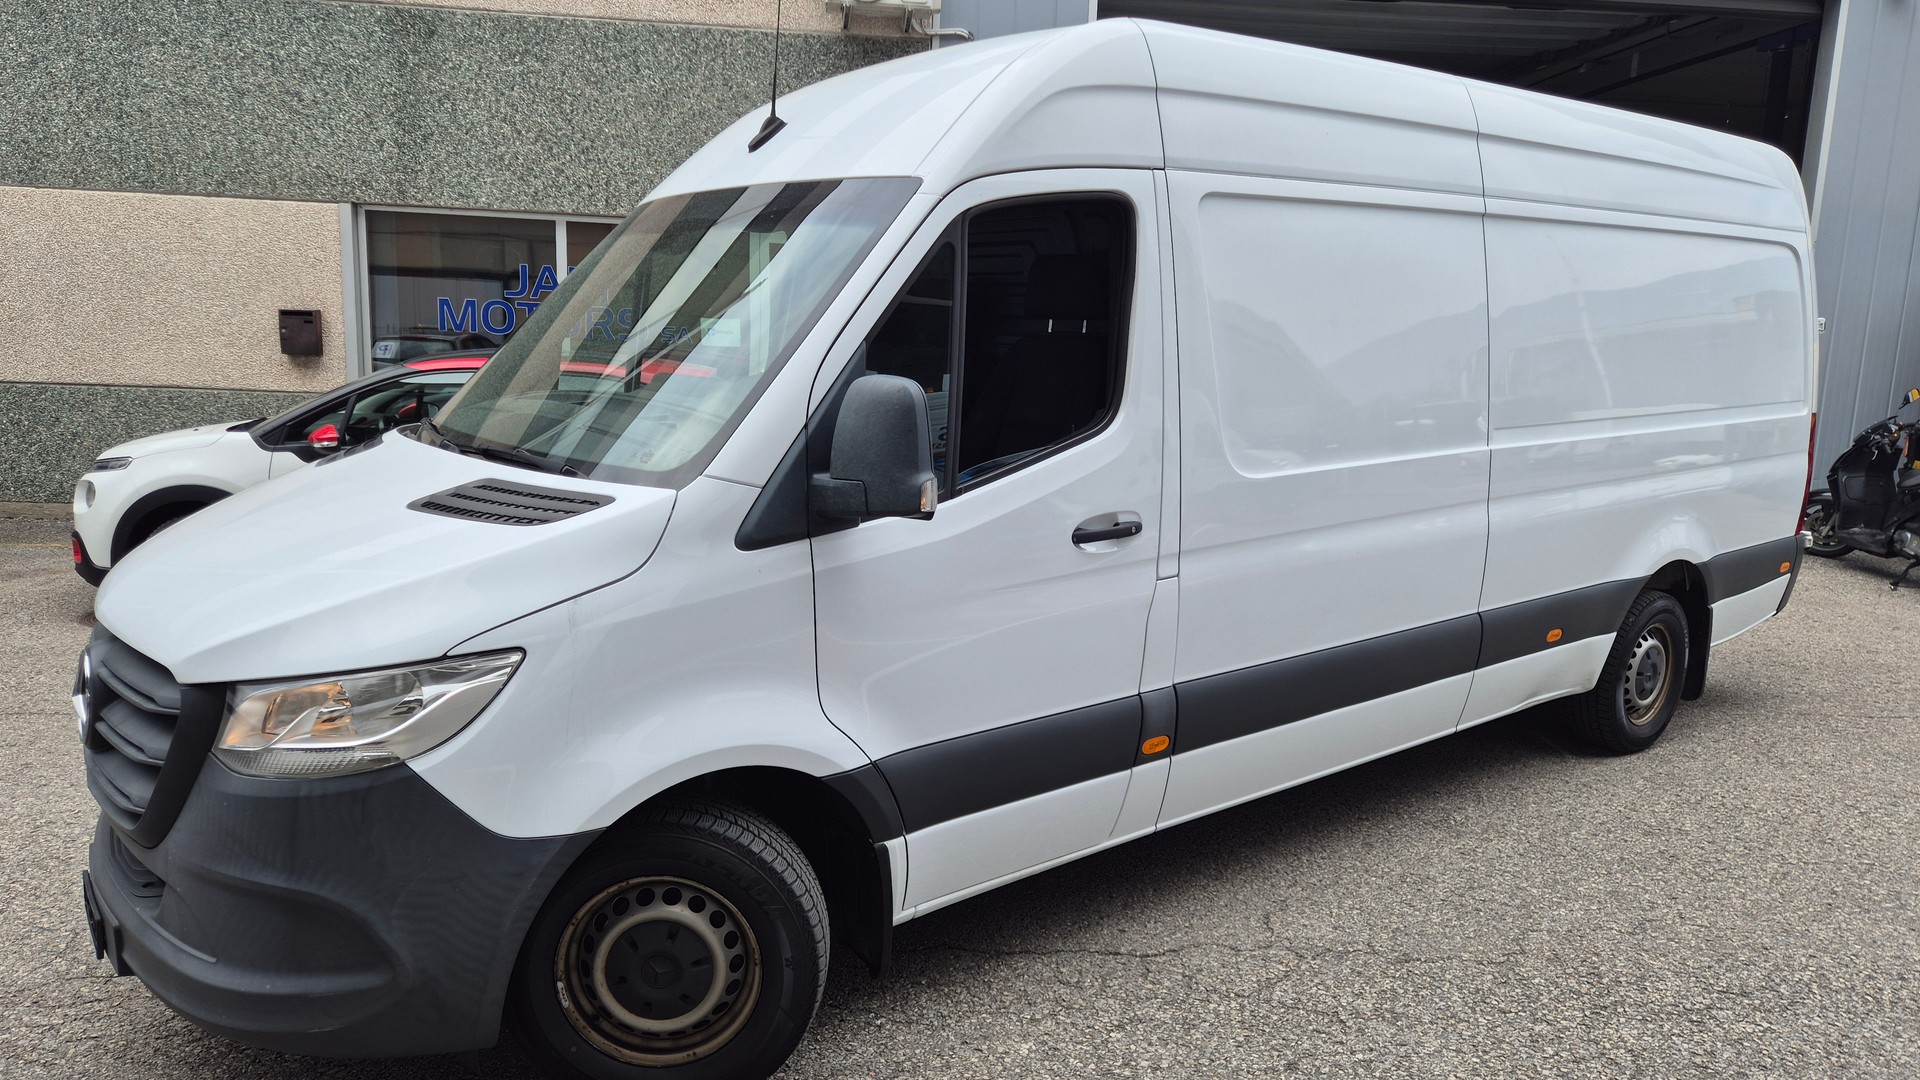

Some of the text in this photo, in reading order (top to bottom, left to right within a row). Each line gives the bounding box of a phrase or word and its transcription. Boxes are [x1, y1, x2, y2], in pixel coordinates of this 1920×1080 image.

[504, 264, 609, 303] JA
[437, 297, 694, 344] MOTRS SA
